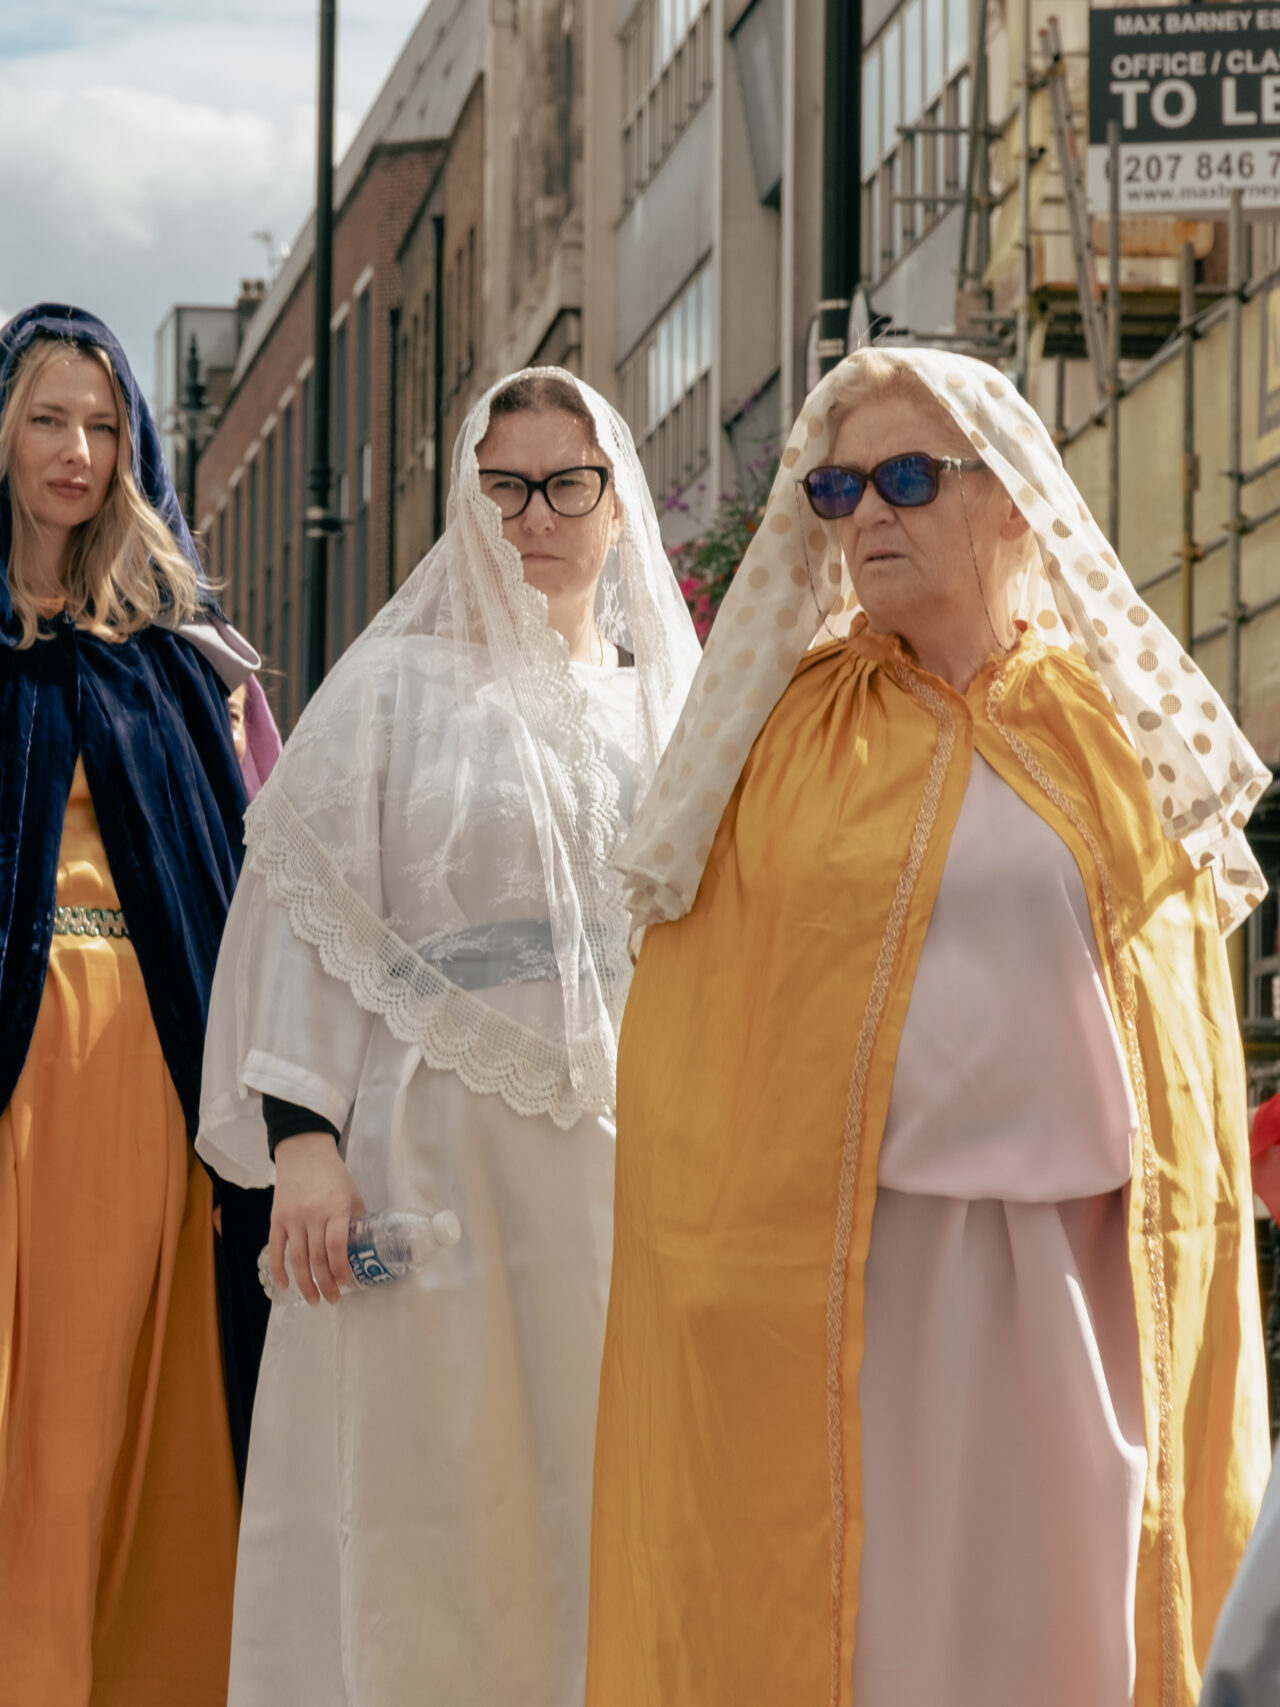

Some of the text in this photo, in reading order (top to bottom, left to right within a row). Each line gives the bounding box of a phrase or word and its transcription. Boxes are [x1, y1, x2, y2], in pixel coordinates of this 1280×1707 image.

[1114, 14, 1162, 36] MAX
[1164, 10, 1252, 34] BARNEY
[1111, 48, 1280, 79] OFFICE / CLA
[1109, 78, 1197, 129] TO
[1105, 153, 1183, 184] 207
[1196, 150, 1254, 182] 846
